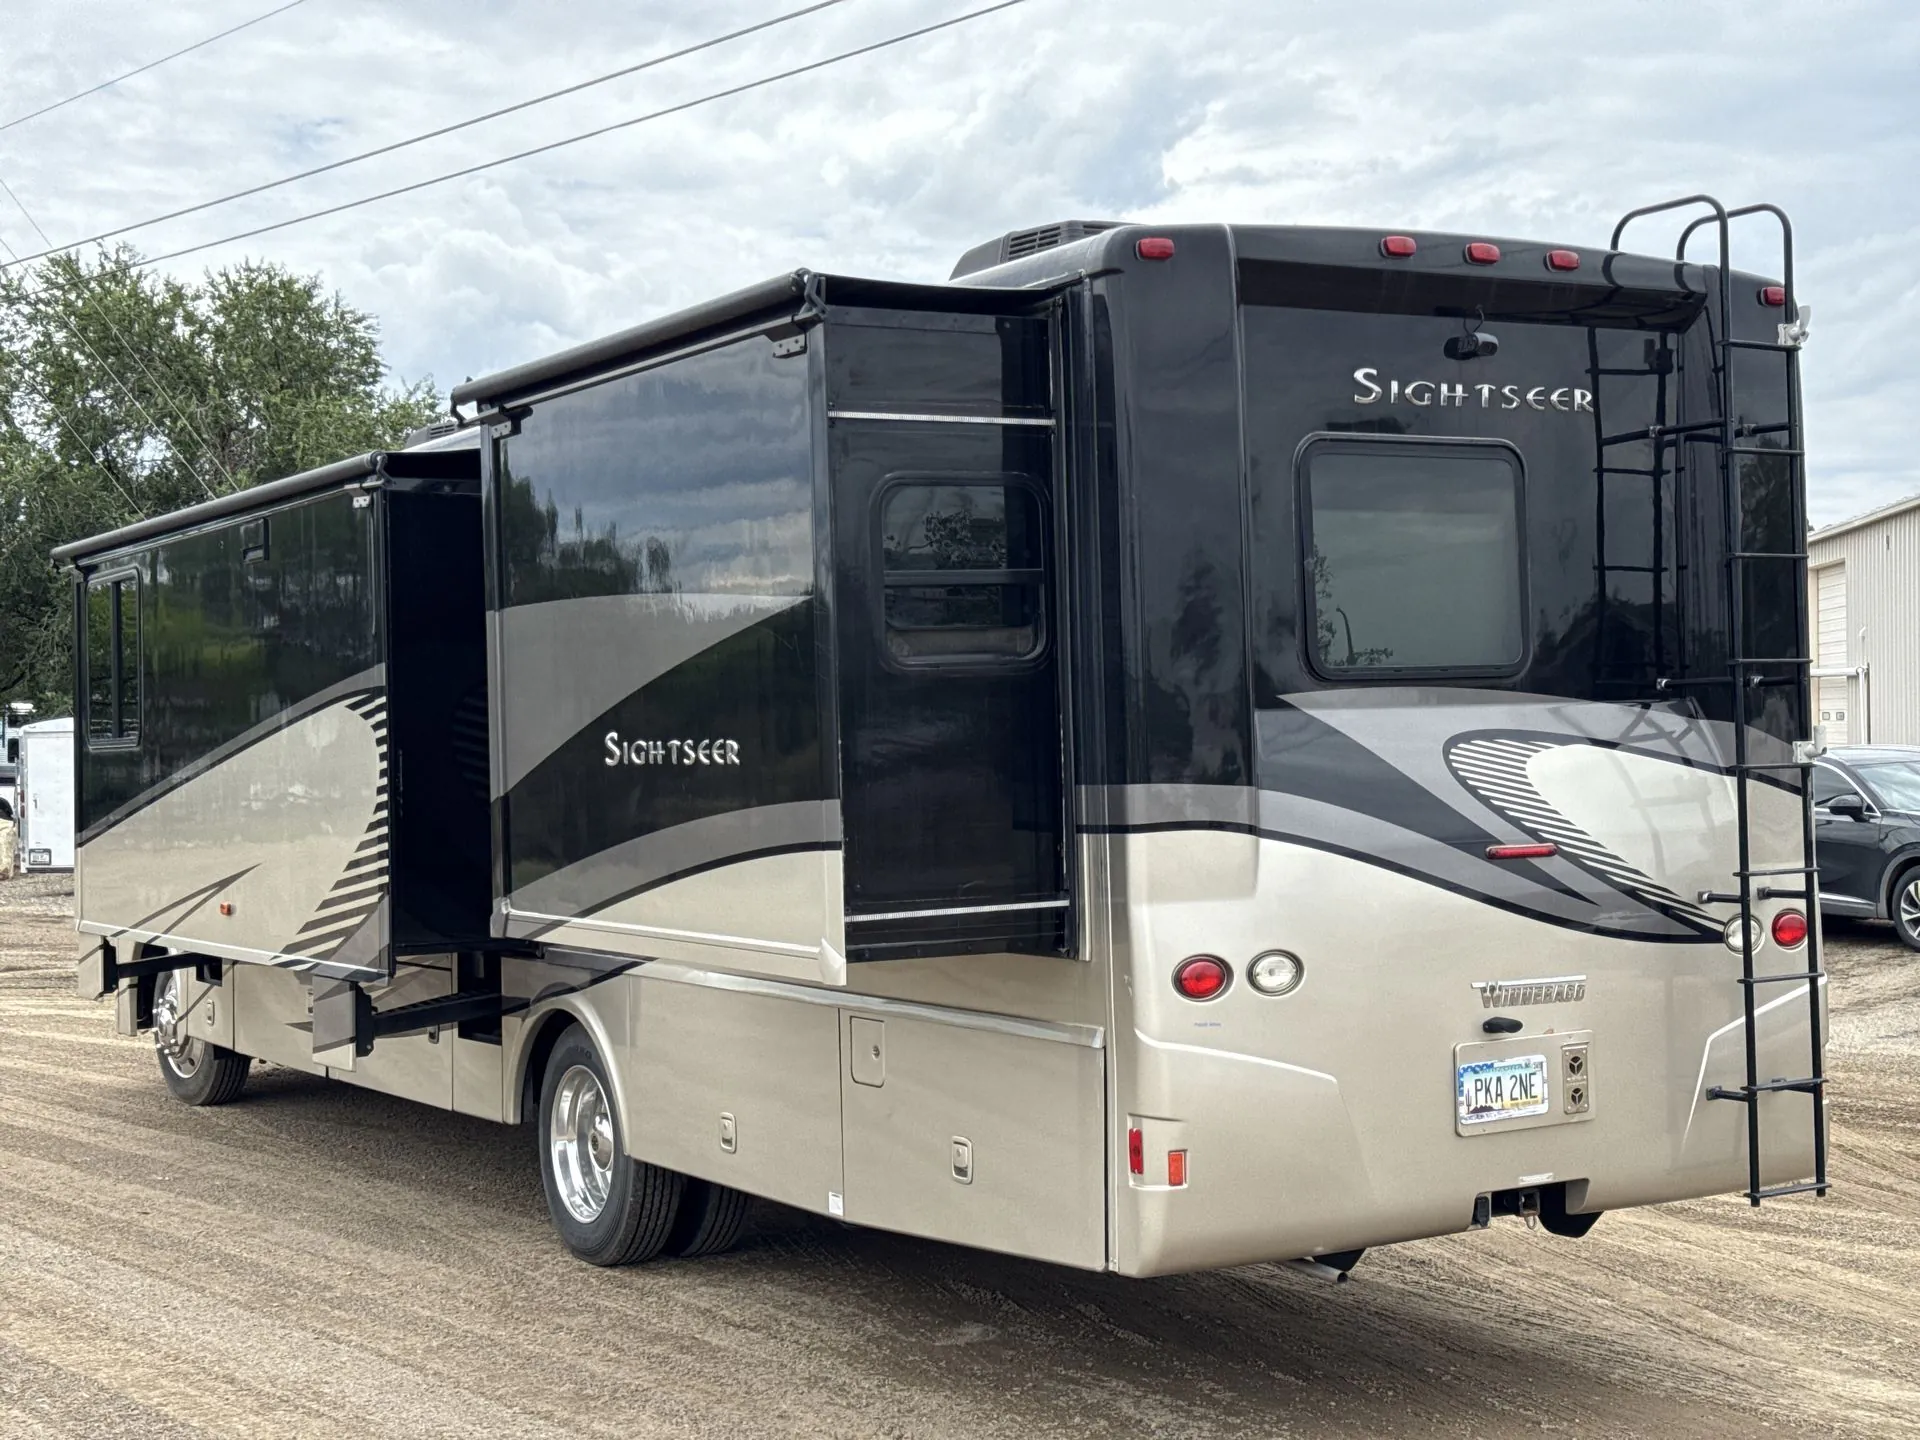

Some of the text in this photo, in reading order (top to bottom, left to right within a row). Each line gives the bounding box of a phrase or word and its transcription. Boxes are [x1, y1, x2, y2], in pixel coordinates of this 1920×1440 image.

[1353, 367, 1594, 413] SIGHTSEER
[604, 730, 741, 767] SIGHTSEER
[1480, 979, 1586, 1008] WINNEBAGO
[1474, 1072, 1538, 1106] PKA 2NE
